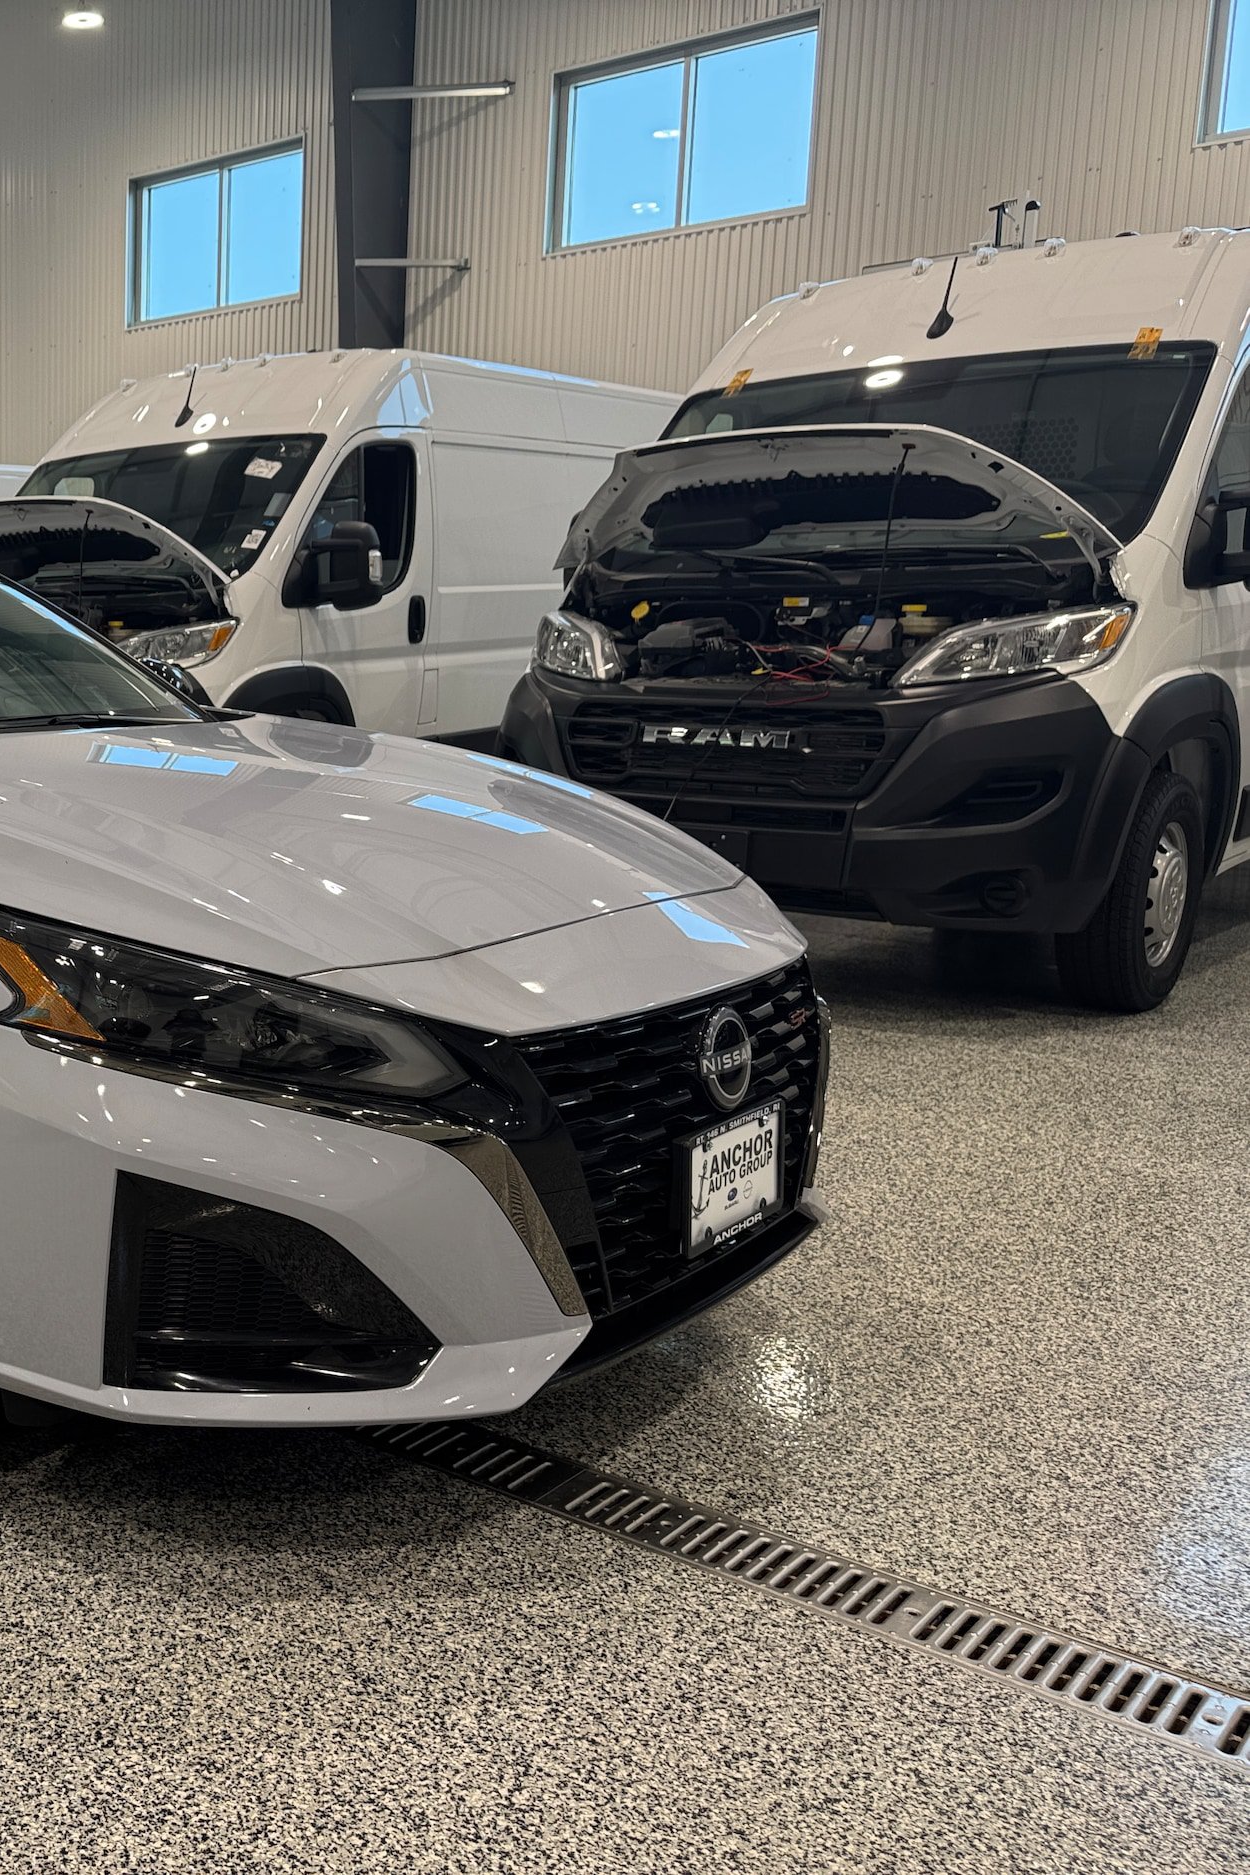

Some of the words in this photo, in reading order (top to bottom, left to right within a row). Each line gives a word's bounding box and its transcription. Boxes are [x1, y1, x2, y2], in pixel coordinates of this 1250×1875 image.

[642, 725, 791, 749] RAM
[772, 1102, 781, 1113] RI
[709, 1129, 773, 1179] ANCHOR
[708, 1169, 736, 1195] AUTO
[739, 1150, 773, 1179] GROUP
[713, 1212, 763, 1246] ANCHOR
